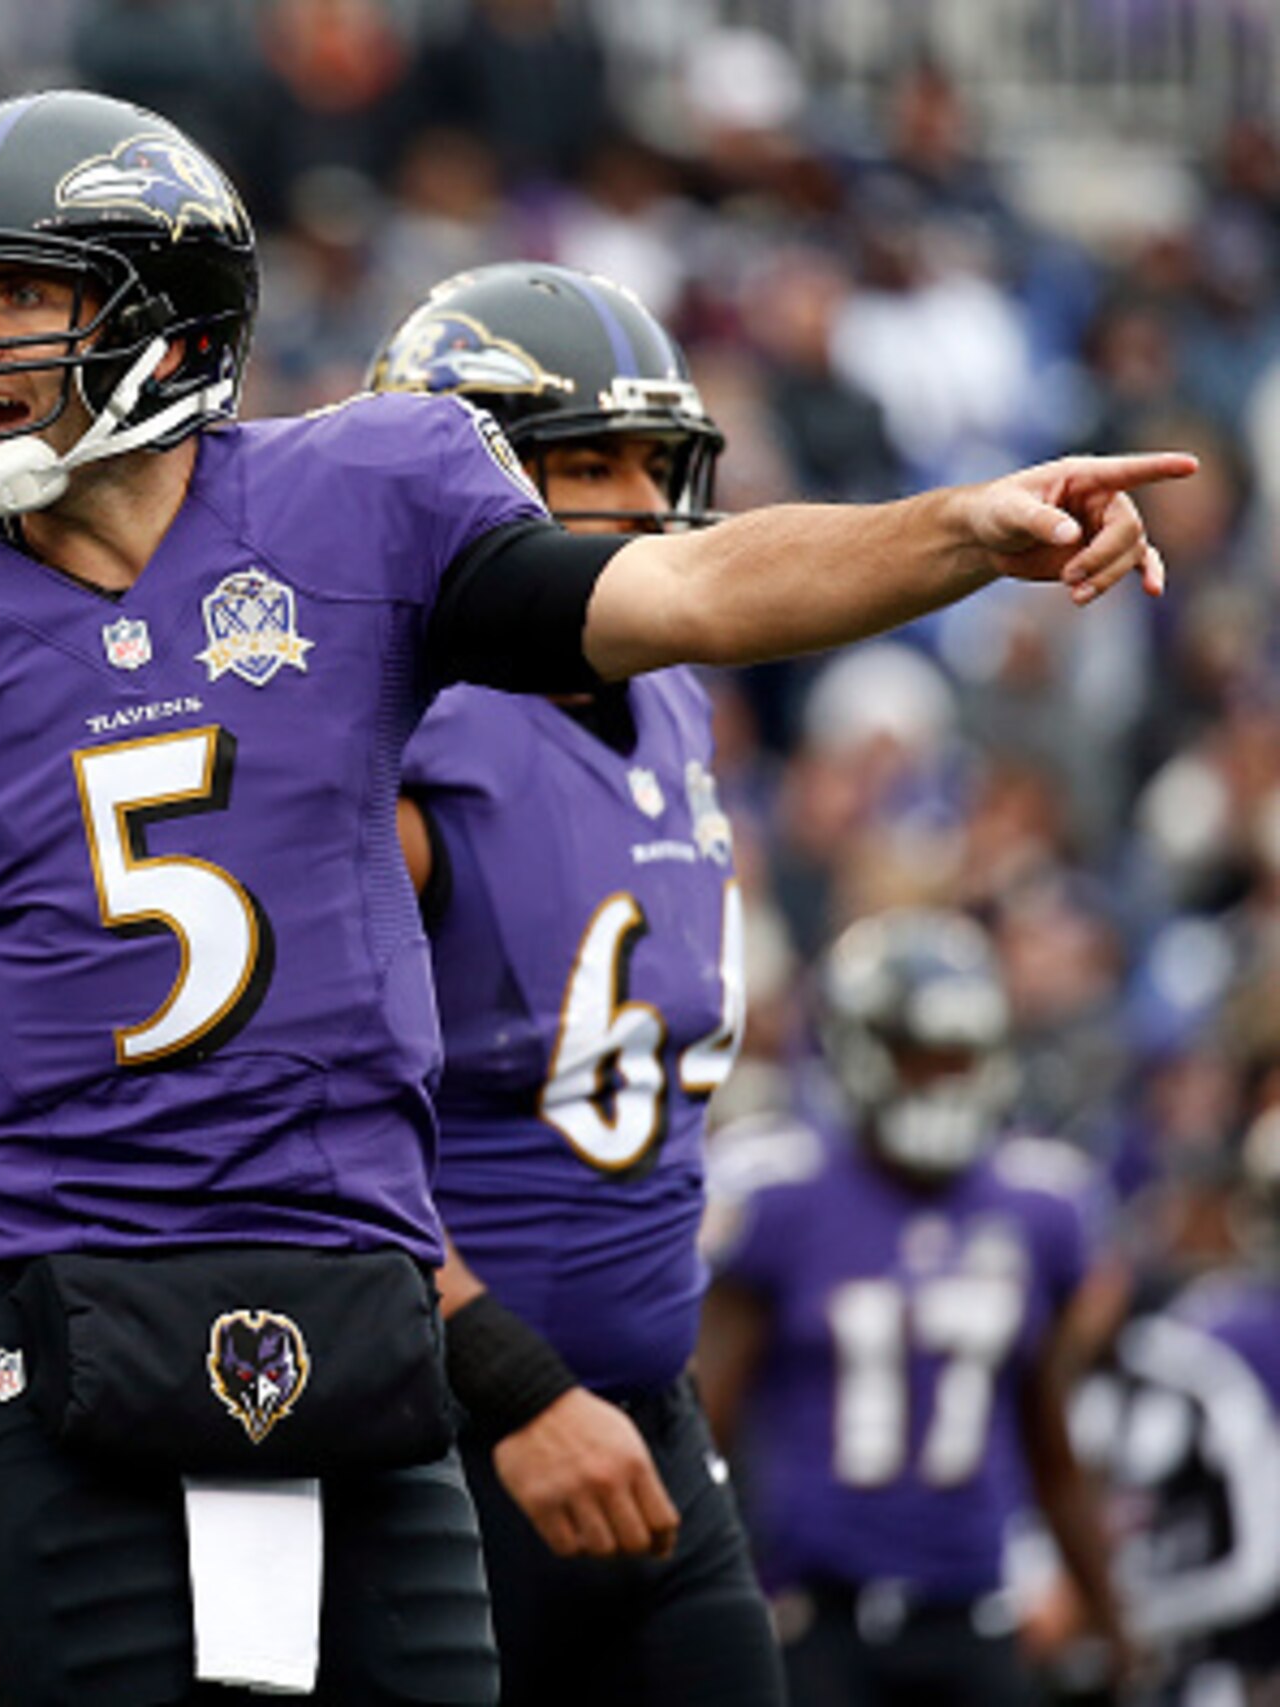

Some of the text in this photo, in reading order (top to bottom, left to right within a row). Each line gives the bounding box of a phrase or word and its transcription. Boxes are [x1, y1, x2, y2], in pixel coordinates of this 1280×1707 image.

[86, 697, 204, 733] RAVENS
[71, 724, 274, 1073] 5
[830, 1277, 1023, 1489] 17
